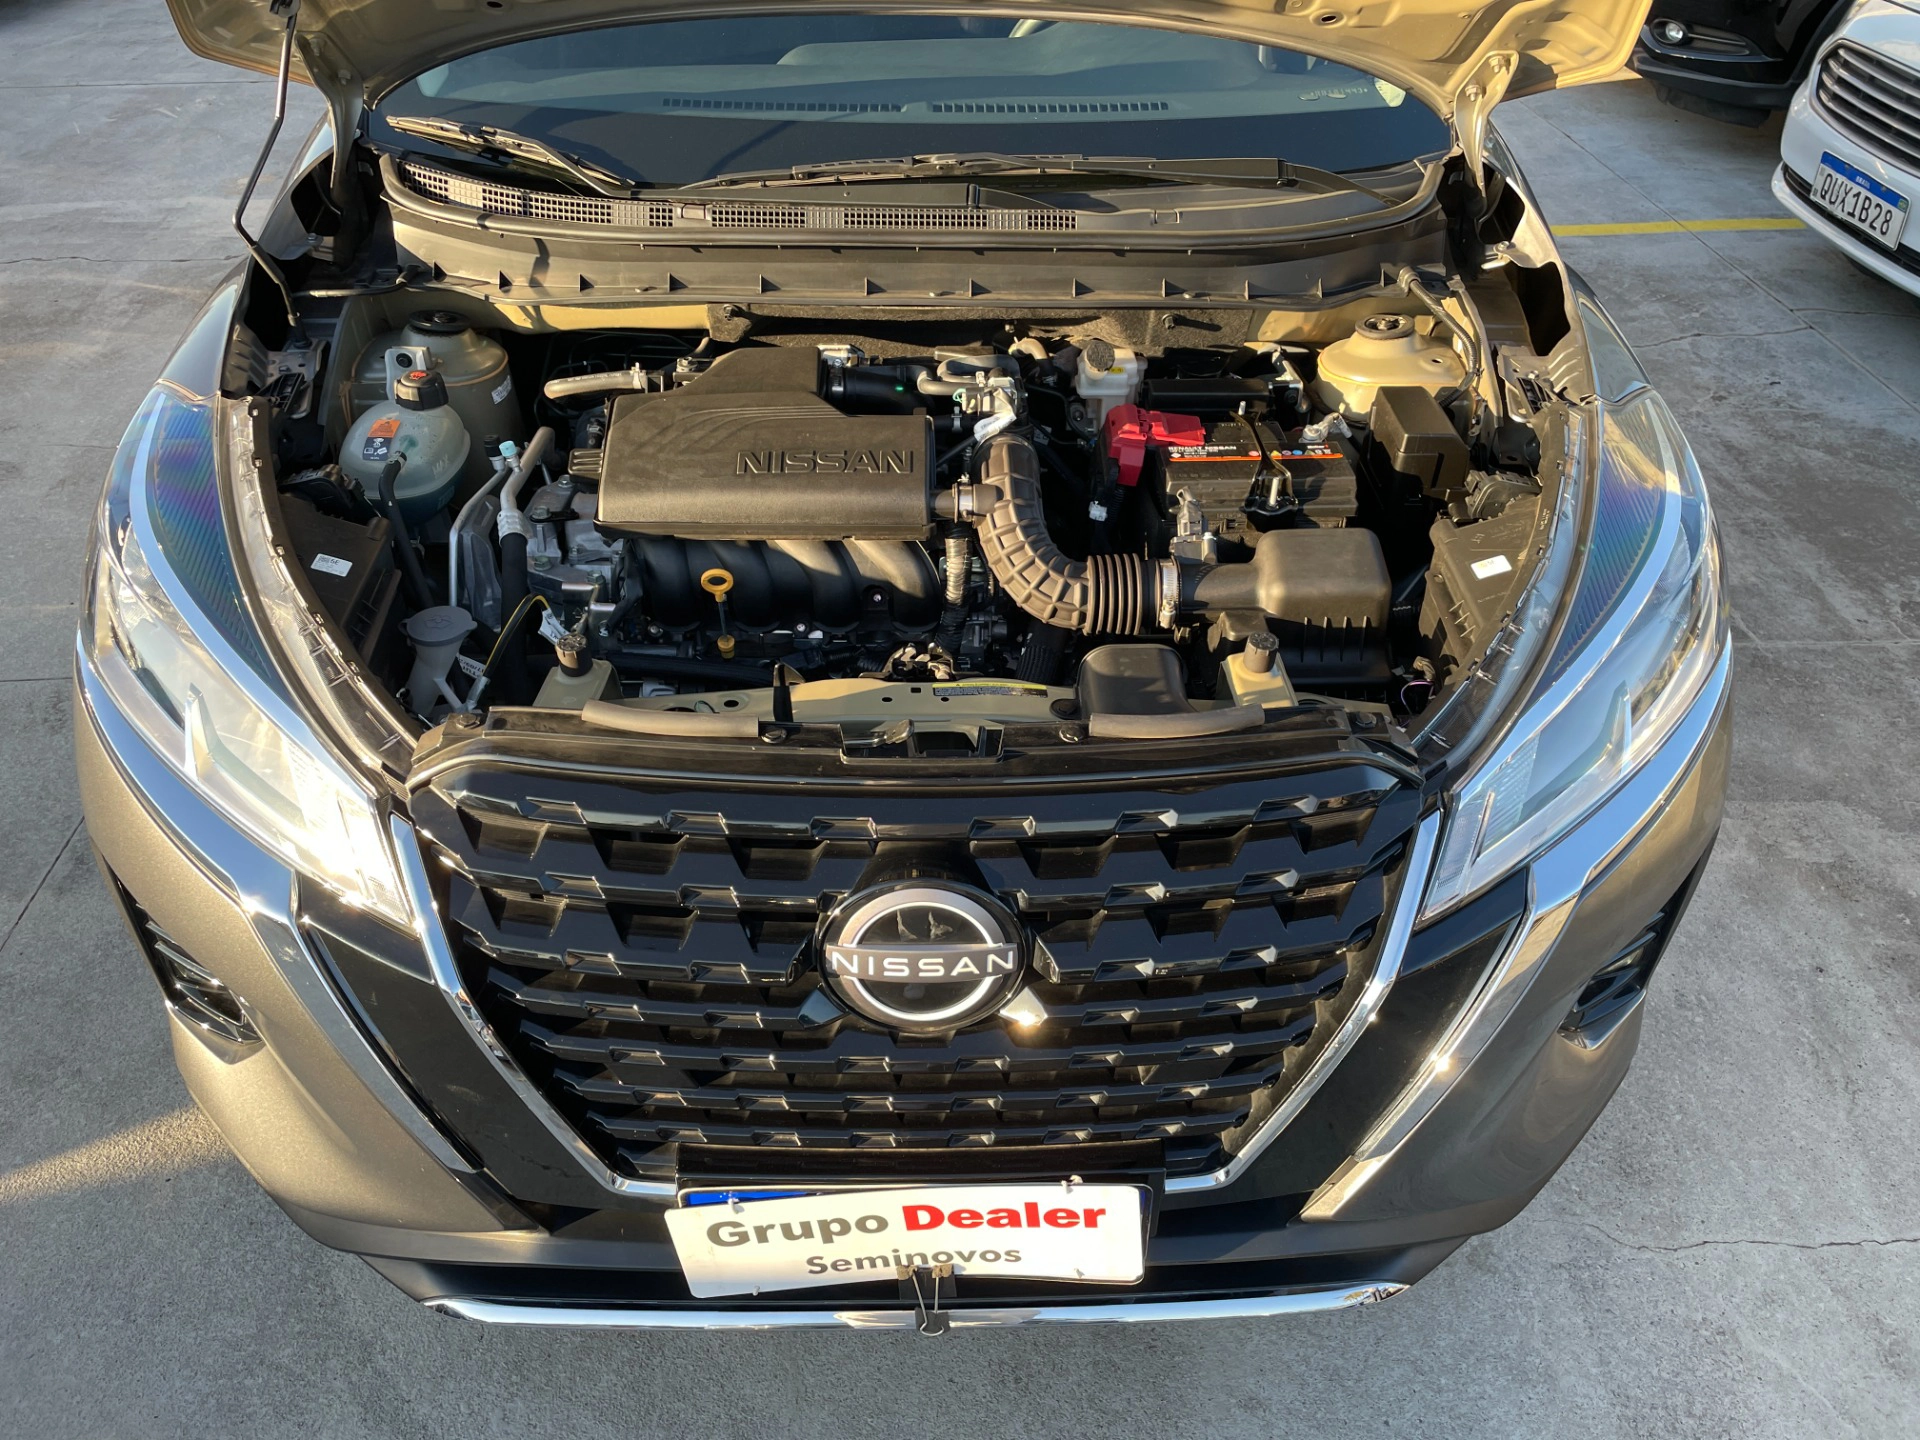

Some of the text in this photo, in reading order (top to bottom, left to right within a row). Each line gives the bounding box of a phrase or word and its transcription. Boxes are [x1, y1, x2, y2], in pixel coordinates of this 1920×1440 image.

[1820, 173, 1893, 236] QUX1B28
[736, 450, 914, 475] NISSAN
[831, 950, 1013, 977] NISSAN
[706, 1202, 1107, 1247] Grupo Dealer
[806, 1246, 1023, 1275] Seminovos
